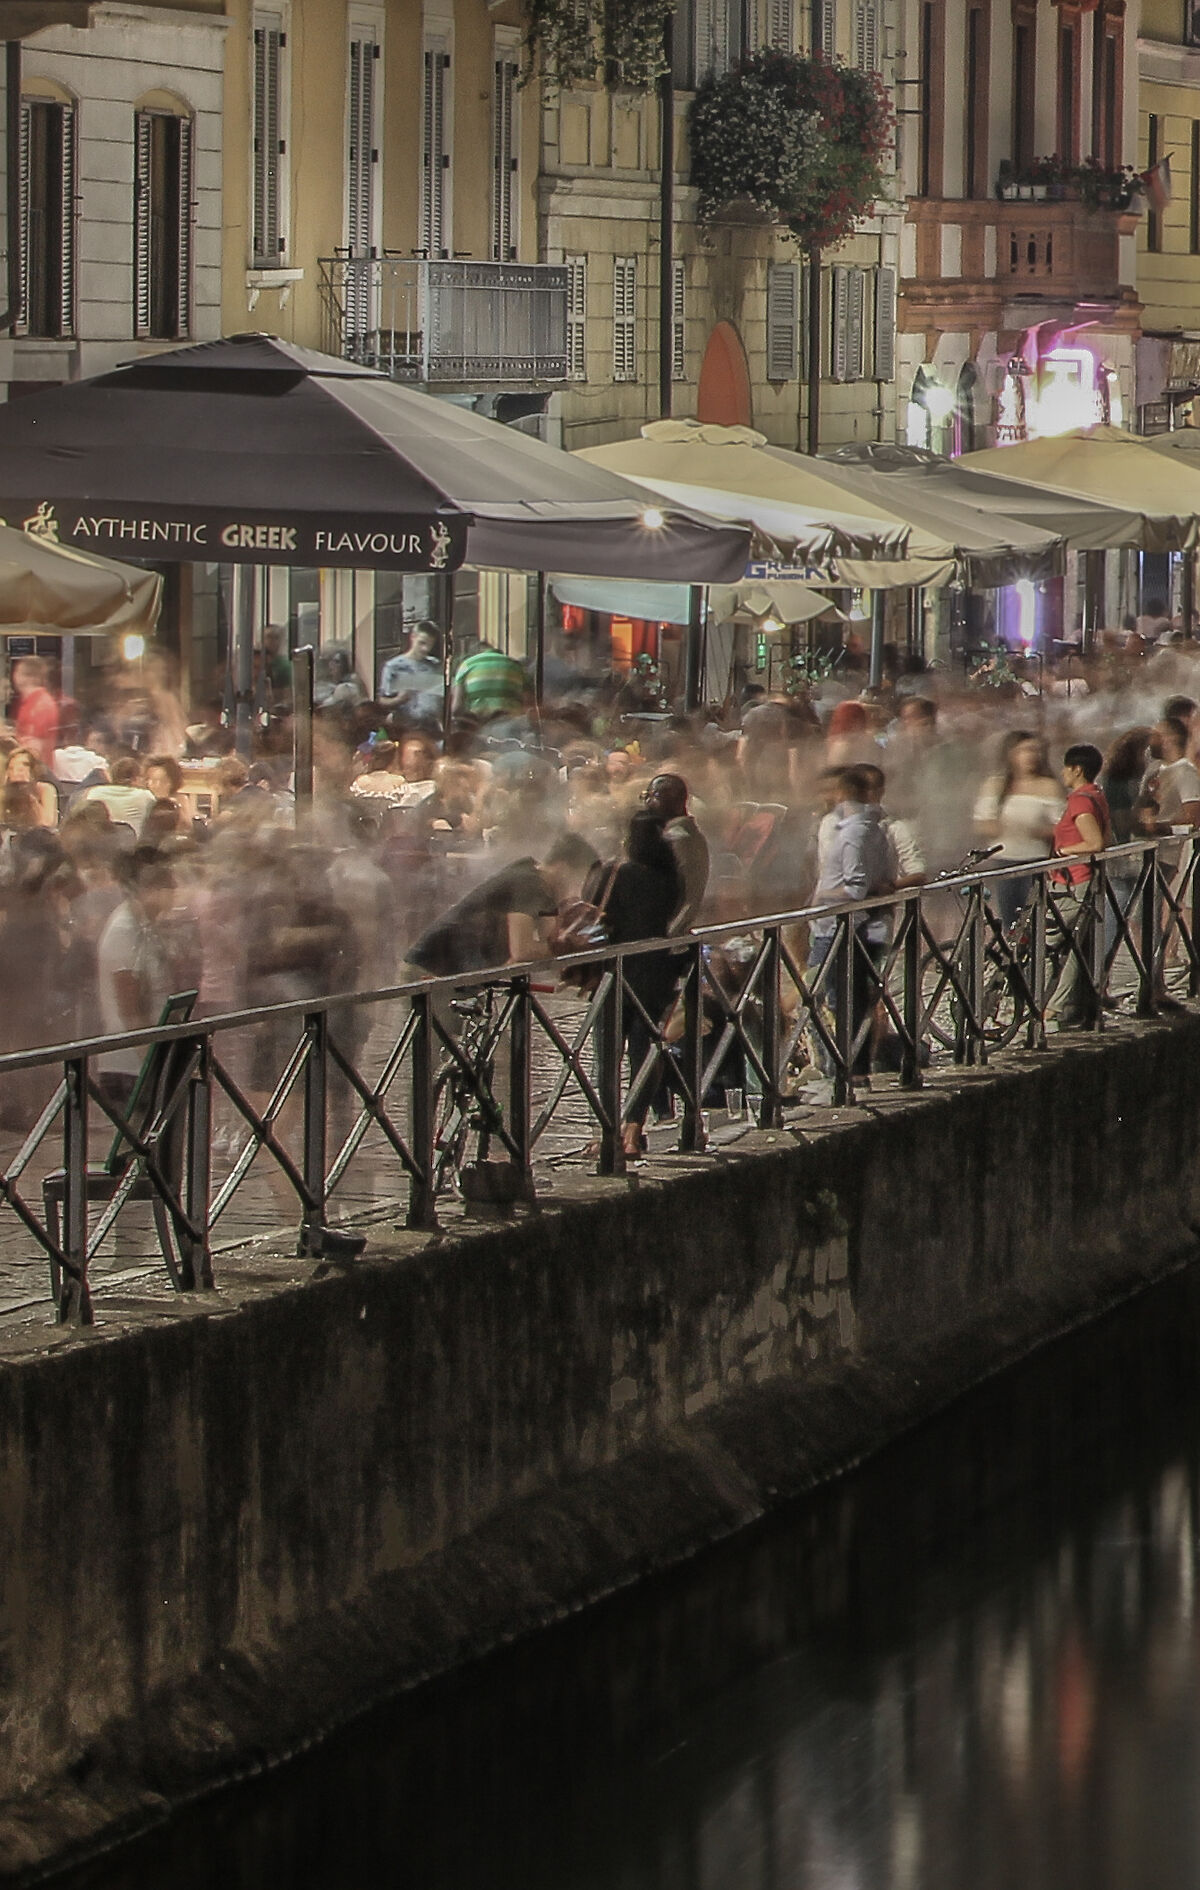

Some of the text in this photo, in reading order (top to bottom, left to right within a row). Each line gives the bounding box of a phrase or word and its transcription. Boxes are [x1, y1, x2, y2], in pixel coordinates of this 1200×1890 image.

[72, 516, 422, 554] AYTHENTIC GREEK FLAVOUR
